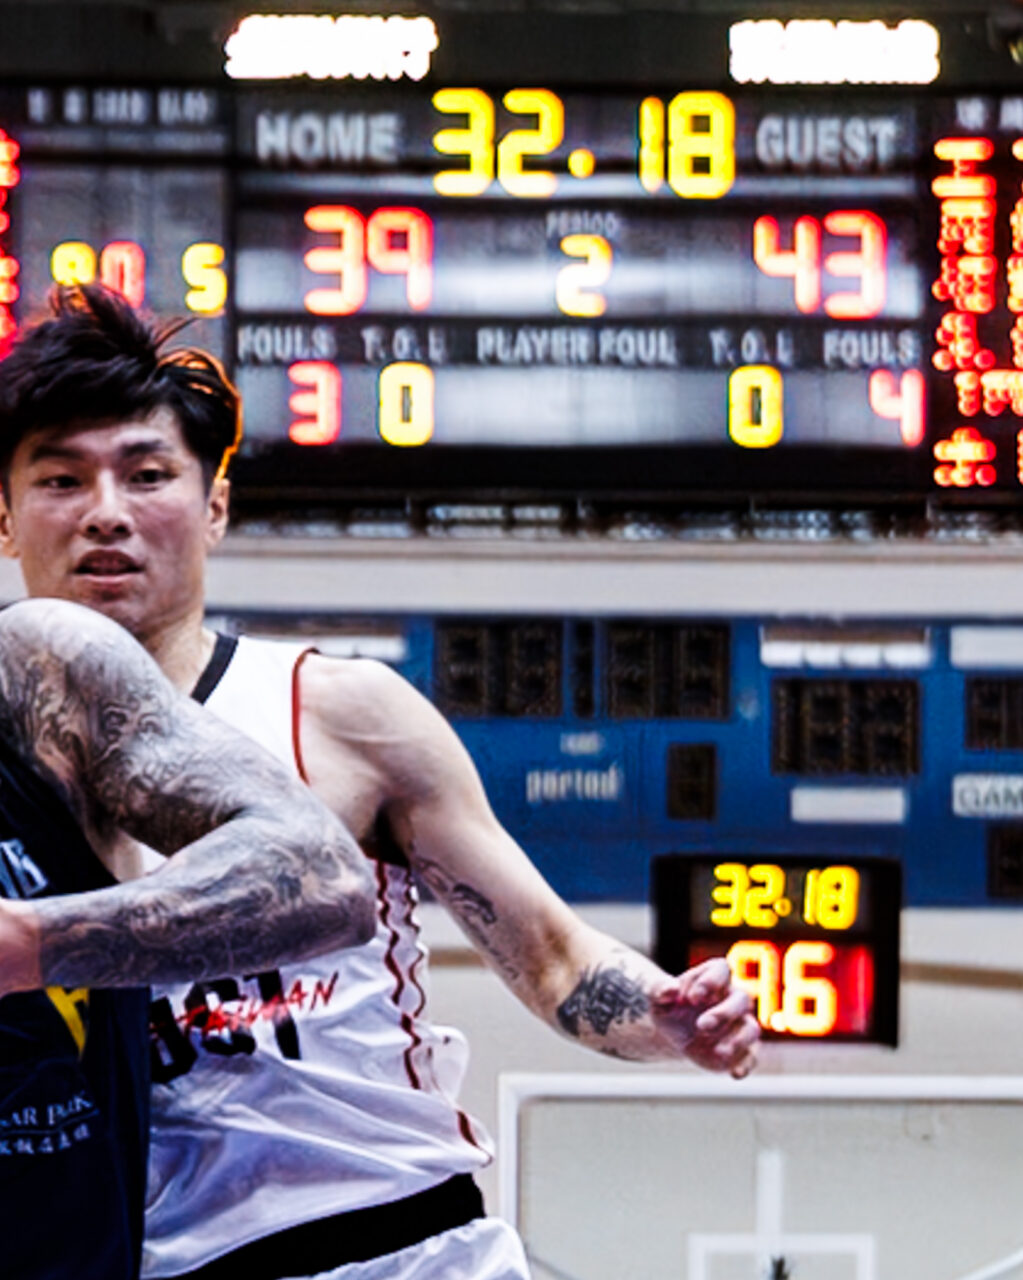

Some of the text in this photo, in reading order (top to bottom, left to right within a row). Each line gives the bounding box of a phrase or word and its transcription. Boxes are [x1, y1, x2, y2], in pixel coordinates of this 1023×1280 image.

[257, 112, 400, 161] HOME
[756, 115, 898, 166] GUEST
[303, 204, 434, 316] 39
[555, 234, 613, 317] 2
[753, 210, 888, 320] 43
[237, 325, 334, 359] FOULS
[477, 326, 591, 361] PLAYER
[599, 328, 676, 362] FOUL
[823, 331, 916, 363] FOULS
[287, 360, 342, 446] 3
[378, 360, 435, 447] 0
[728, 364, 784, 448] 0
[869, 368, 926, 447] 4
